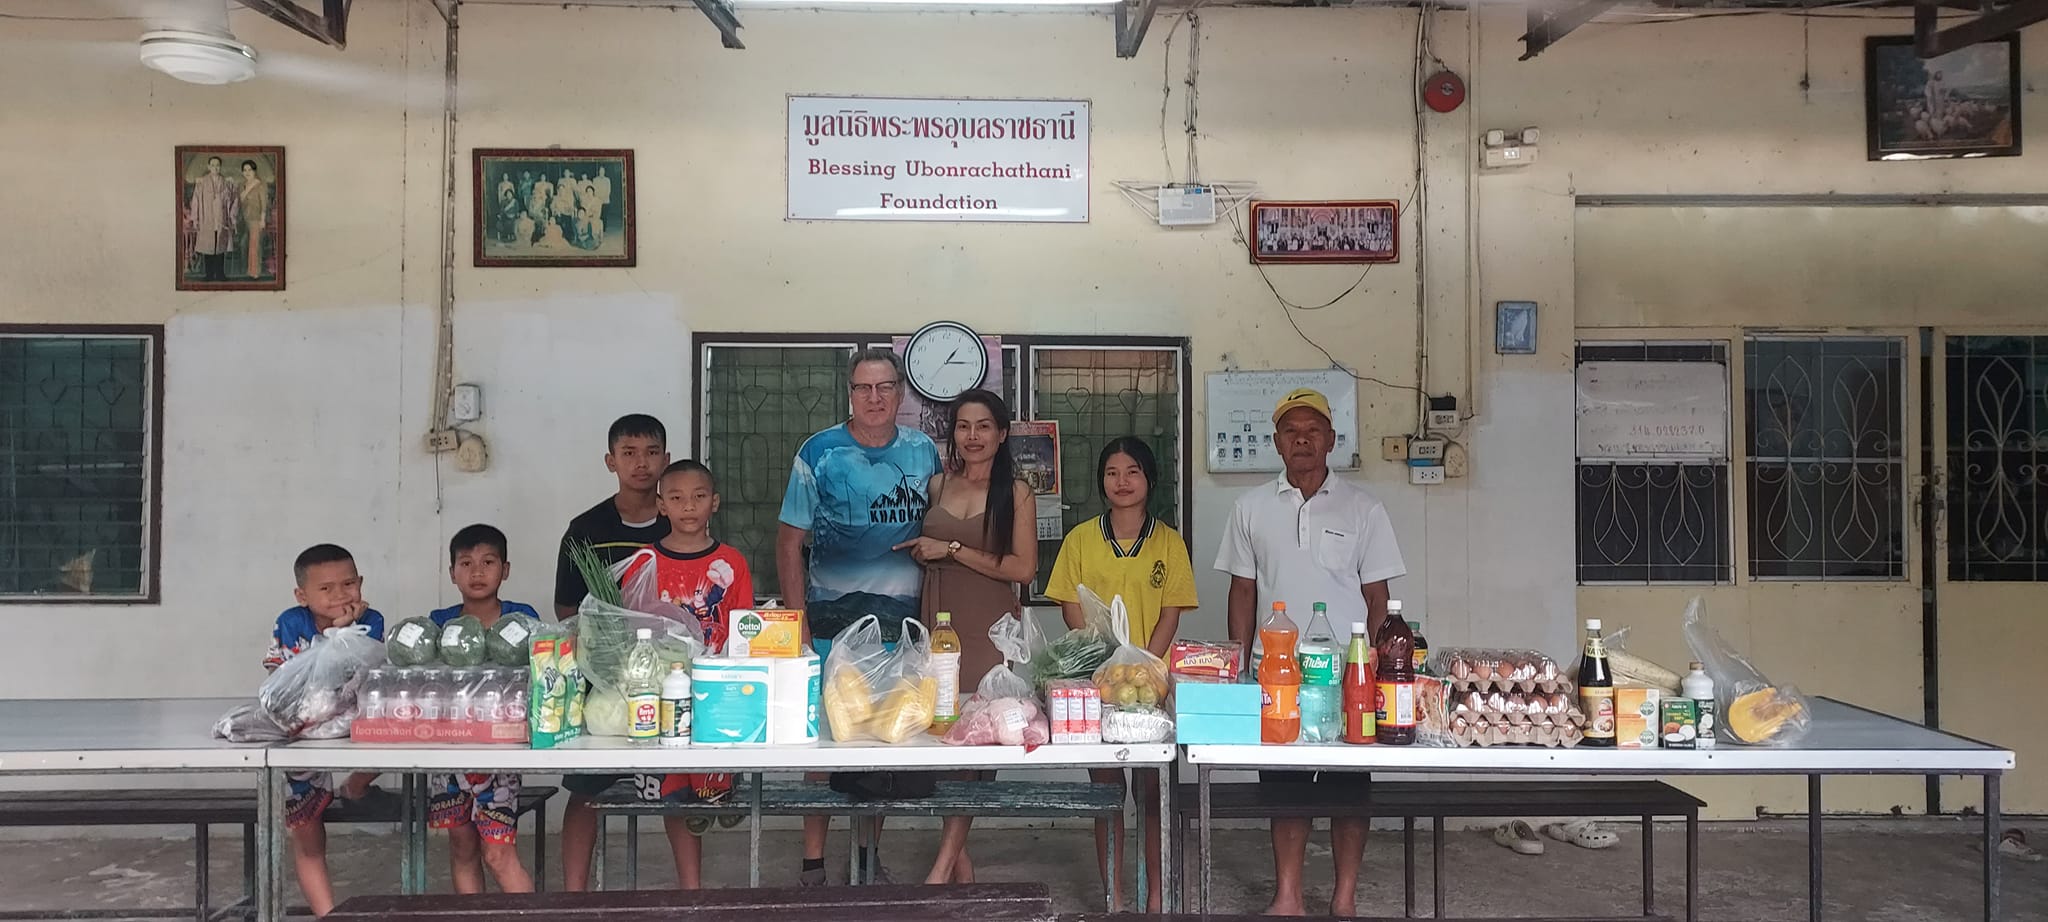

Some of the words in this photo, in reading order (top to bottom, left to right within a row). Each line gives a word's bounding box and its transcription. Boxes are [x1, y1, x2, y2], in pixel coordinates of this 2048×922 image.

[803, 110, 1075, 148] มูลนิธิพระพรอุบลราชธานี
[808, 158, 896, 180] Blessing
[906, 160, 1071, 179] Ubonrachathani
[880, 192, 998, 210] Foundation
[738, 622, 761, 631] Dettol
[436, 728, 472, 737] SINGHA
